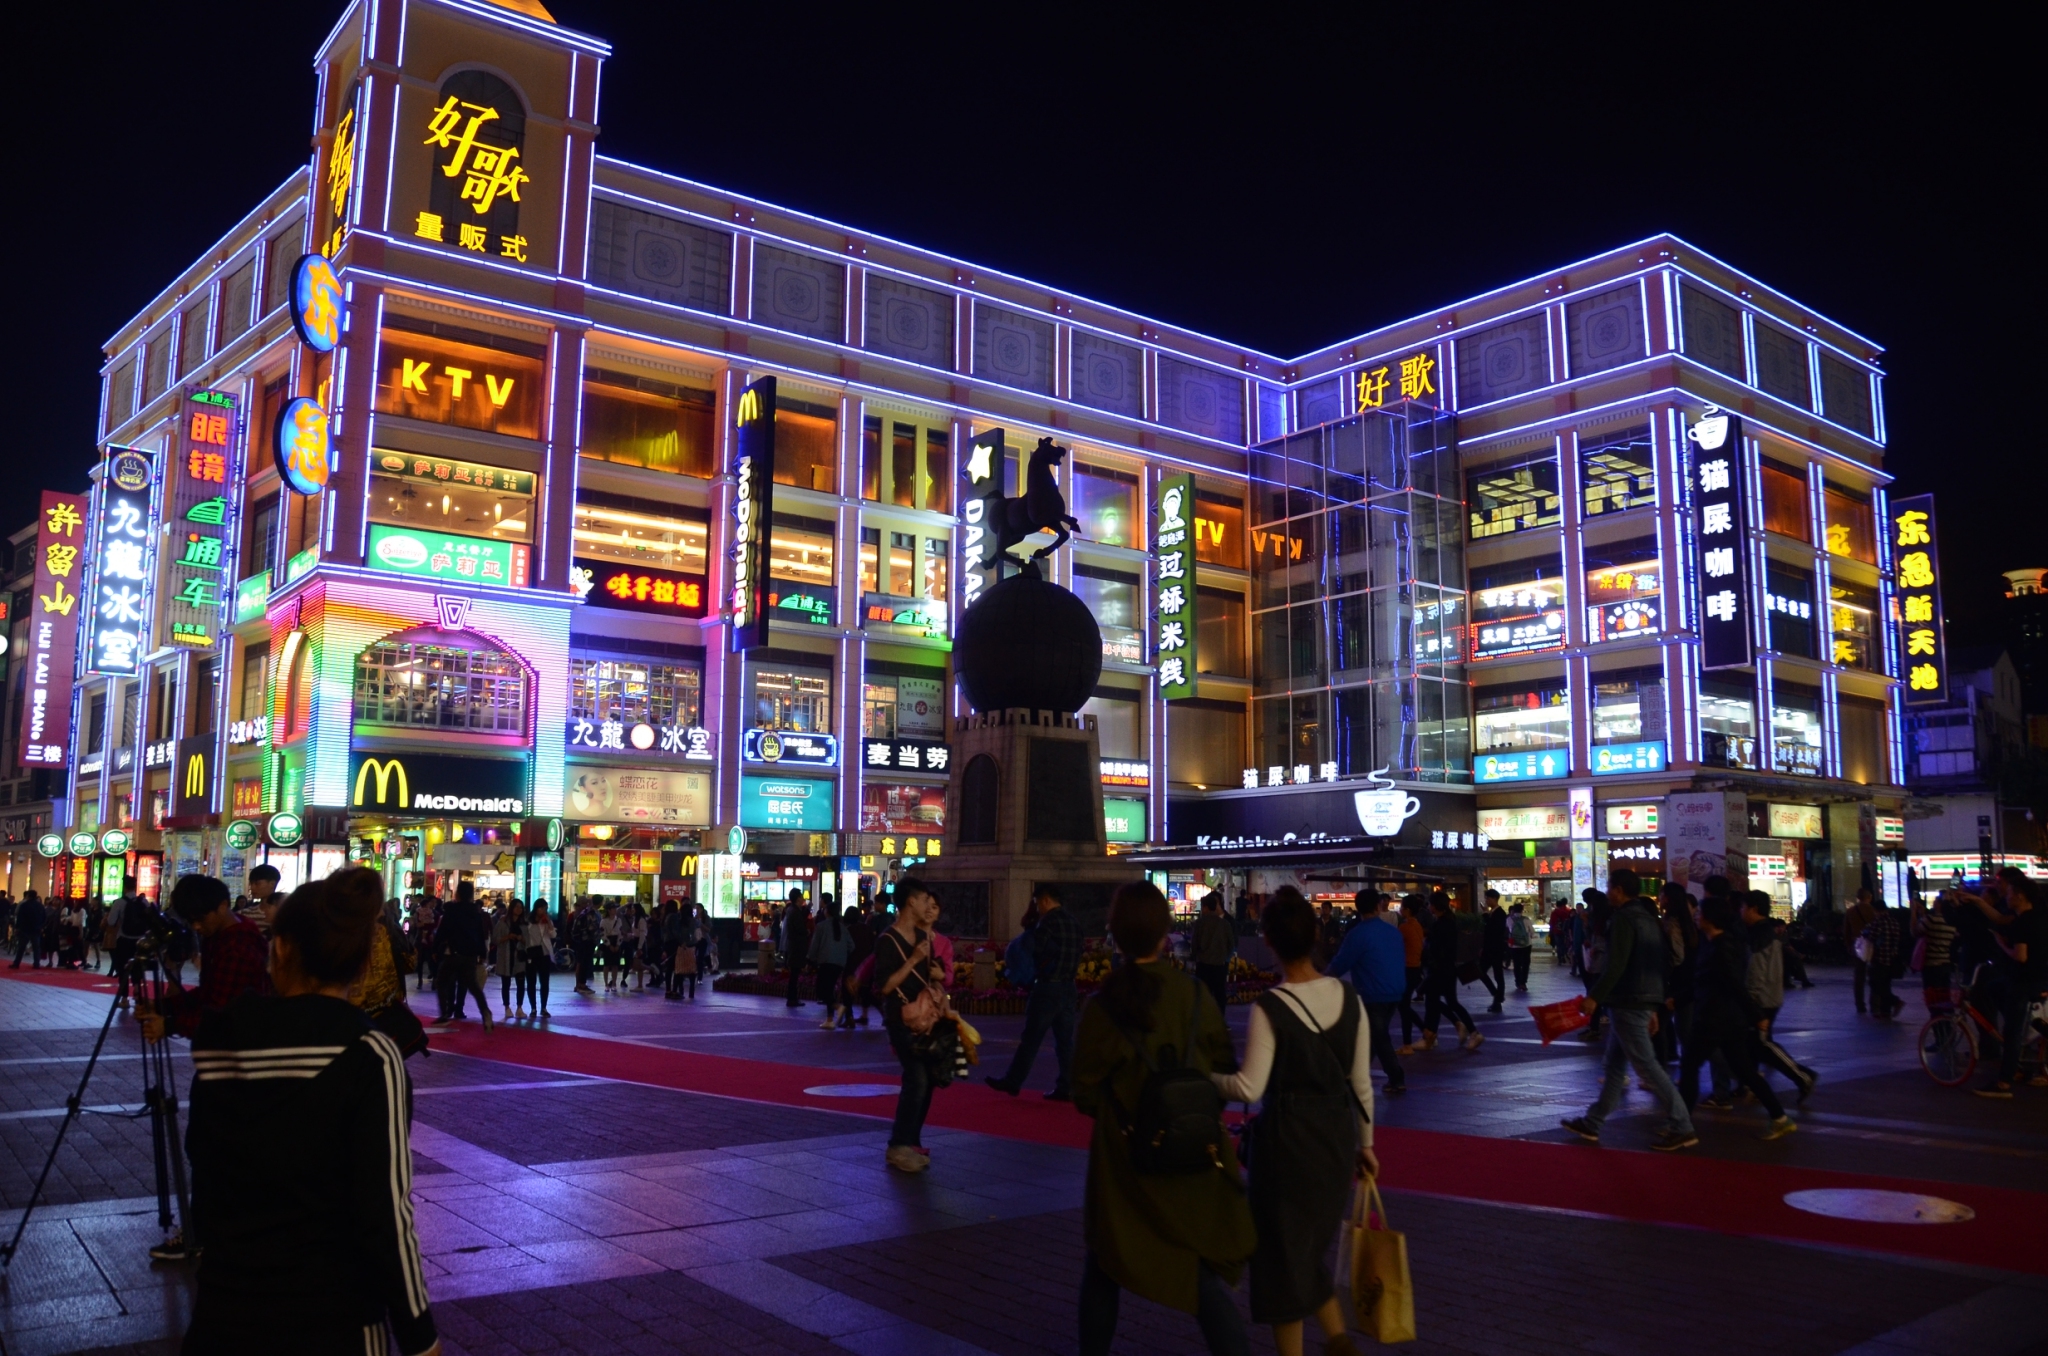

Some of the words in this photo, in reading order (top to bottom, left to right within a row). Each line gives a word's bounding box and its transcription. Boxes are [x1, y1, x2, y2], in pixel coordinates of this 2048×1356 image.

[424, 95, 530, 213] 好歌
[415, 211, 528, 262] 量贩式
[402, 357, 515, 408] KTV
[1356, 353, 1435, 413] 好歌
[190, 391, 235, 408] 直通车
[414, 460, 471, 483] 萨莉亚
[733, 455, 752, 629] McDonald's
[1700, 459, 1737, 622] 猫屎咖啡
[40, 503, 82, 616] 許留山
[431, 553, 502, 579] 萨莉亚
[98, 499, 146, 669] 九龍冰室
[1159, 551, 1187, 688] 过桥米线
[38, 622, 52, 649] HUI
[34, 653, 50, 684] LAU
[31, 688, 47, 732] SHAN
[572, 718, 624, 750] 九龍
[660, 725, 710, 755] 冰室
[25, 744, 62, 763] 三楼
[867, 742, 949, 770] 麦当劳
[620, 776, 658, 790] 蝶恋花
[766, 785, 805, 795] watsons
[1243, 761, 1339, 789] 猫屎咖啡
[414, 793, 524, 813] McDonald's
[767, 800, 804, 815] 屈臣氏
[1431, 830, 1489, 851] 猫屎咖啡
[71, 858, 87, 899] 直通车
